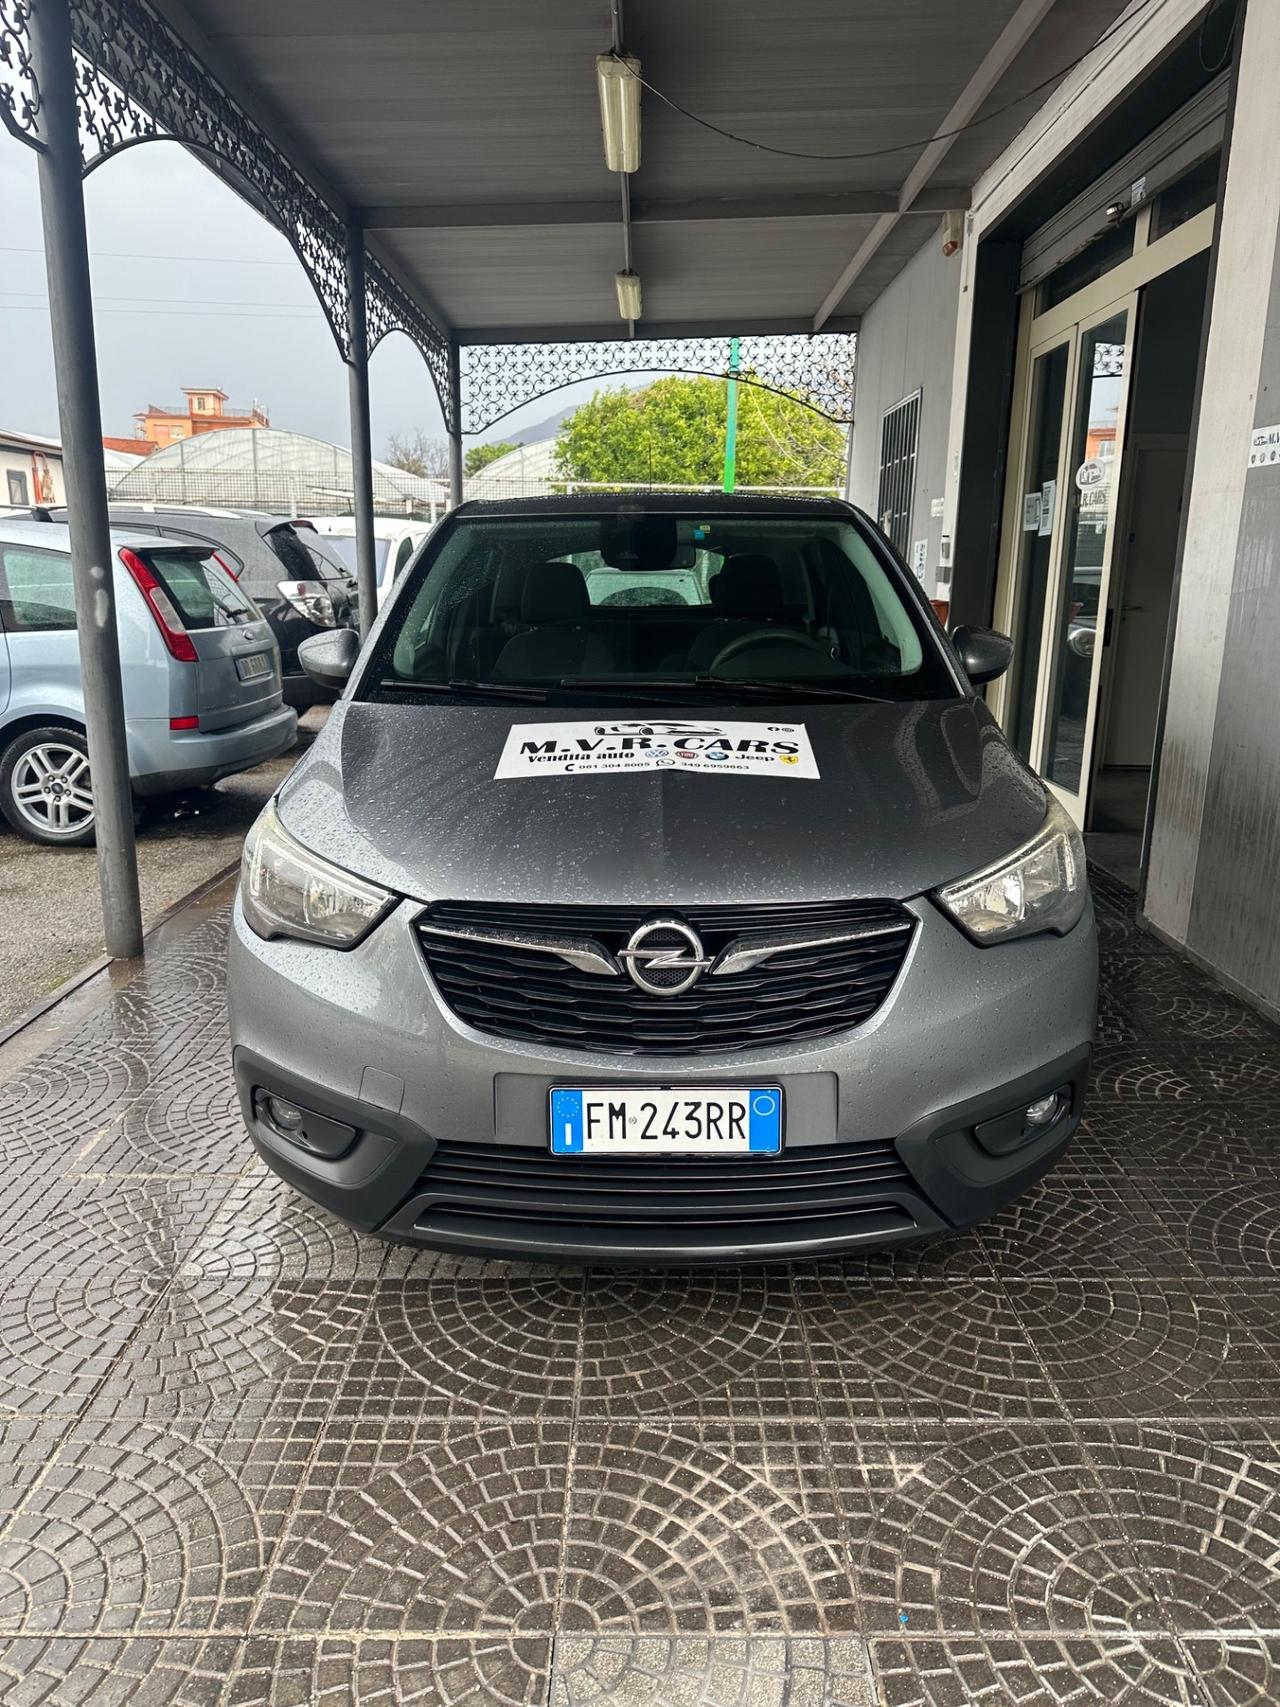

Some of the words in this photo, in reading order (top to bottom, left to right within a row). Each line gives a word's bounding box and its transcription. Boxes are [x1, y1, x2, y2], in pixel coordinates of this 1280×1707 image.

[528, 753, 590, 763] Vendita
[597, 752, 635, 760] auto
[735, 753, 775, 761] Jeep
